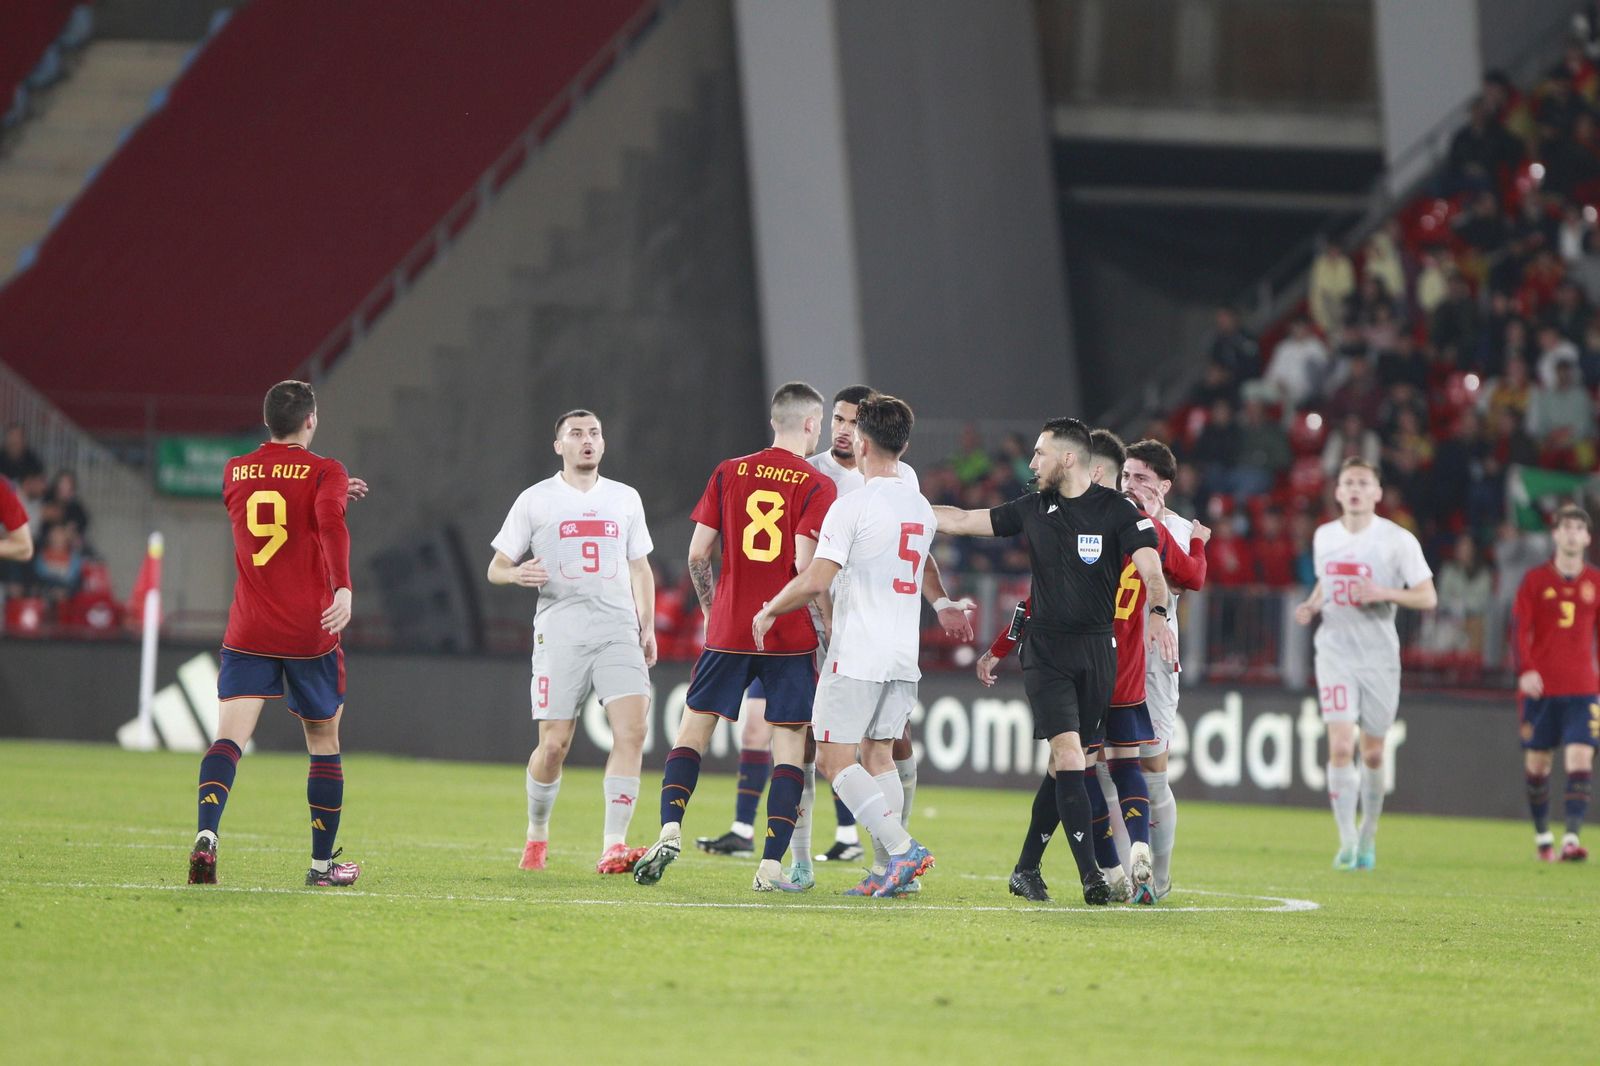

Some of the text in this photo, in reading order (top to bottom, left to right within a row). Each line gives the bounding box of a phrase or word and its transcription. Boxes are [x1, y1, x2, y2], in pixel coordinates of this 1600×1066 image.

[232, 464, 266, 482] ABEL
[272, 464, 311, 480] RUIZ
[755, 465, 809, 485] SANCET
[246, 490, 288, 566] 9
[742, 489, 786, 562] 8
[1080, 536, 1100, 544] FIFA
[582, 541, 600, 573] 9
[893, 522, 924, 595] 5
[1333, 580, 1362, 607] 20
[538, 676, 550, 709] 9
[1322, 685, 1347, 712] 20
